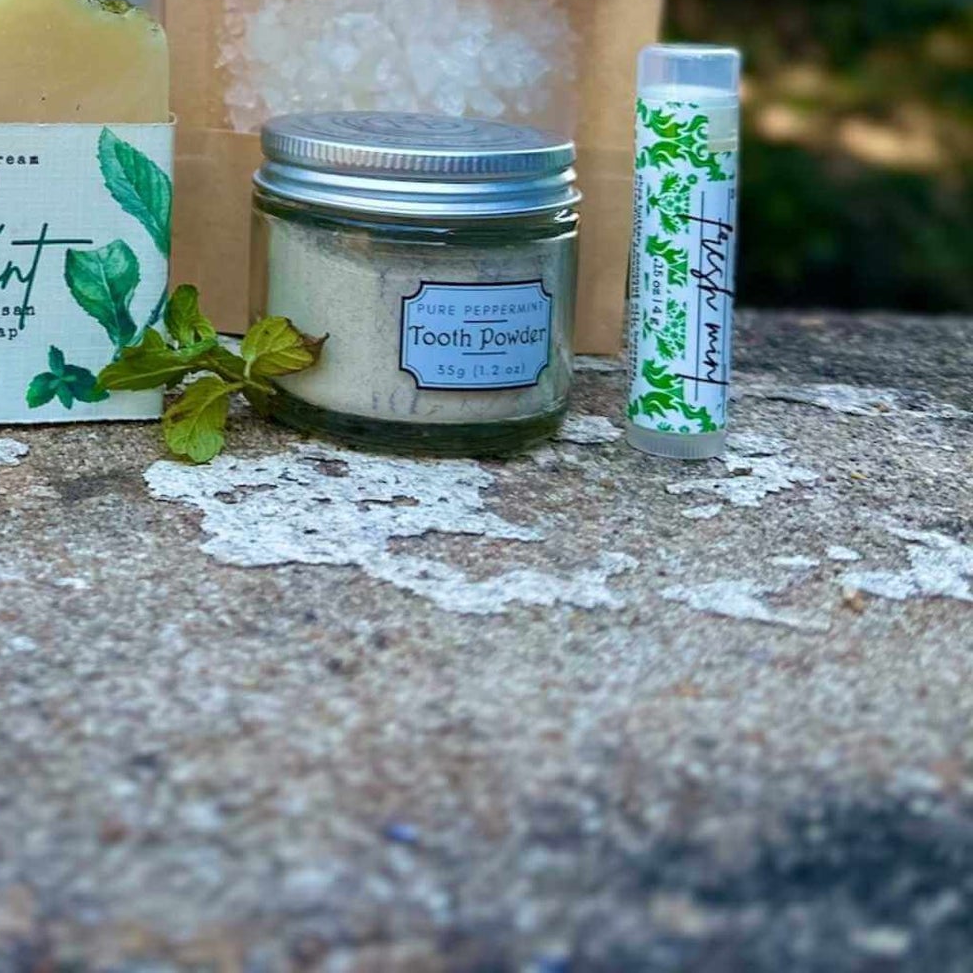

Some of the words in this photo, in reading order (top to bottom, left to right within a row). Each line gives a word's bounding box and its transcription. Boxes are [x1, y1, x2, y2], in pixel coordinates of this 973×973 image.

[677, 213, 734, 312] fresh
[417, 303, 456, 316] PURE
[464, 301, 544, 316] PEPPERMINT
[409, 325, 472, 348] Tooth
[479, 325, 547, 351] Powder
[676, 321, 729, 386] mint
[437, 364, 465, 379] 35g
